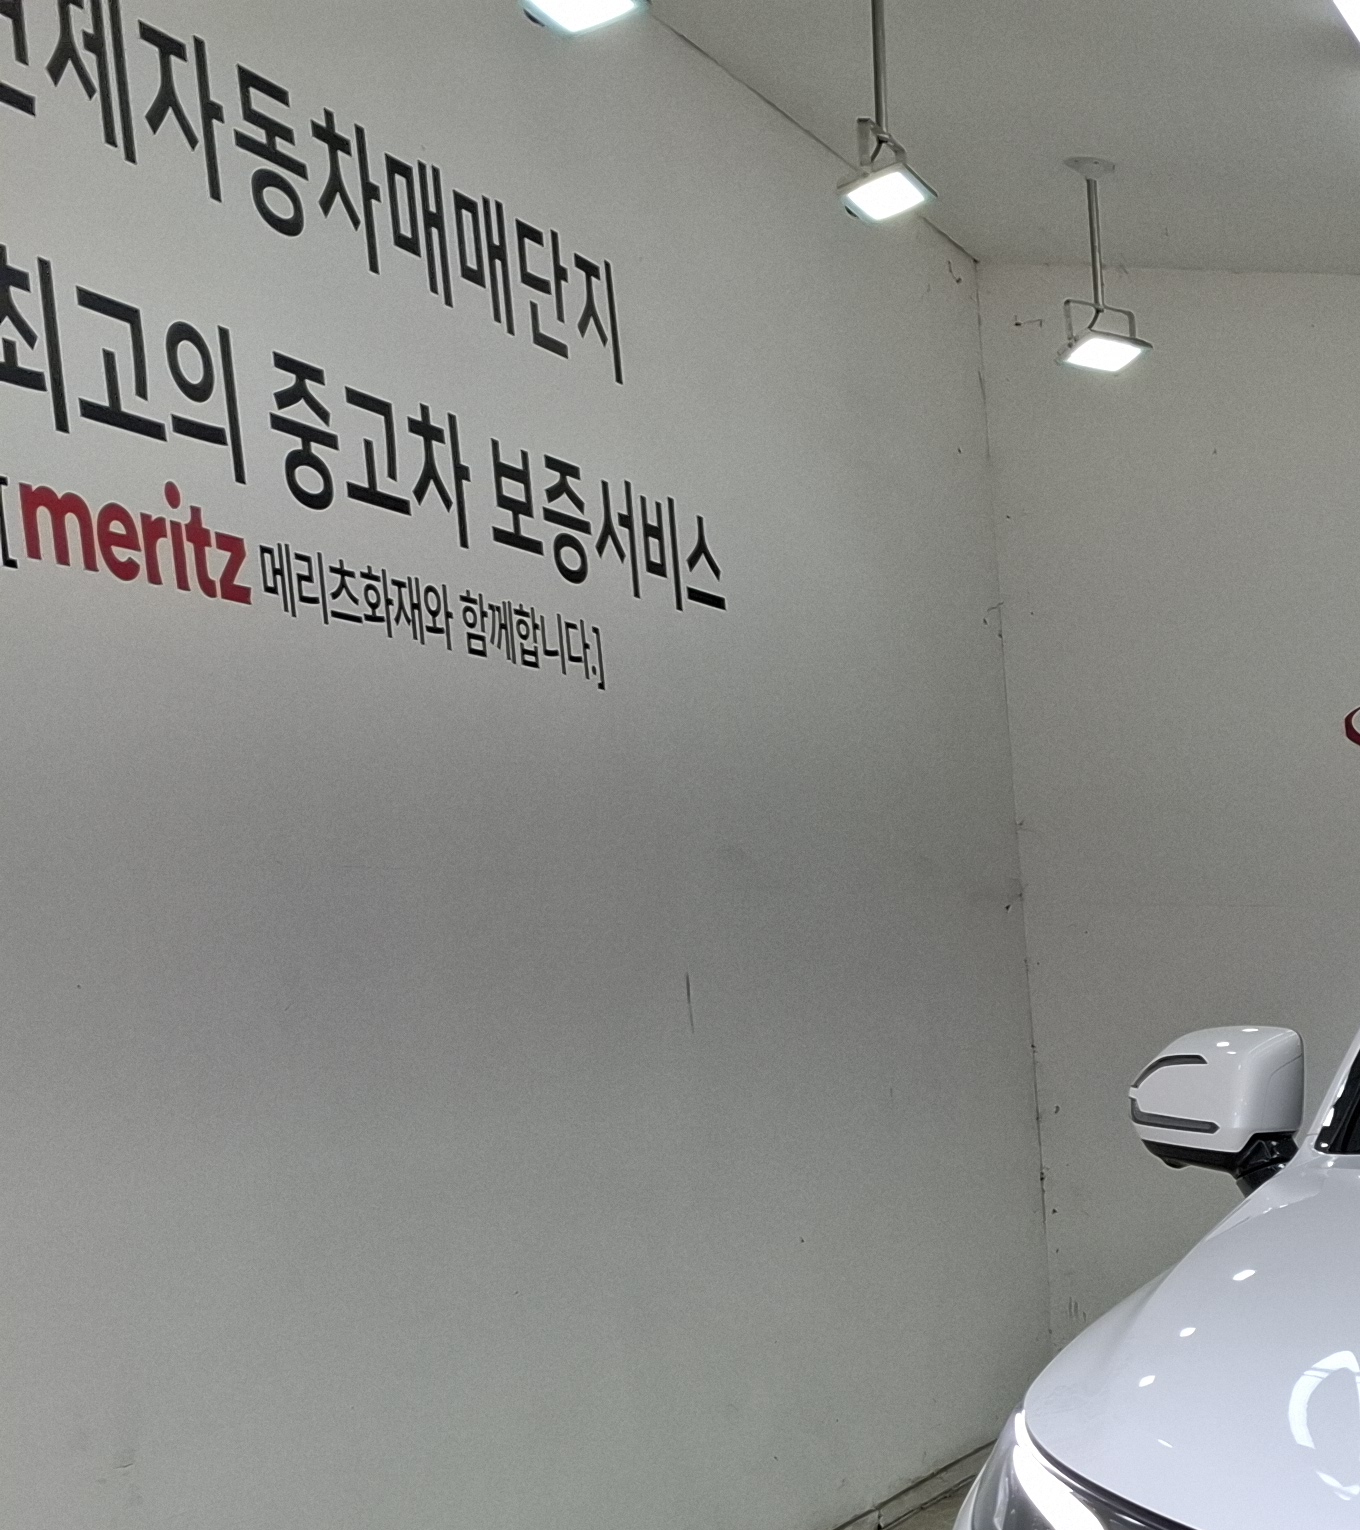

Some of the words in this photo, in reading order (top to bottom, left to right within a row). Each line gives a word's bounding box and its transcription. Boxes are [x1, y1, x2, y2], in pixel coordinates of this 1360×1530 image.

[269, 351, 470, 549] 중고차
[490, 438, 726, 611] 보증서비스
[259, 543, 453, 651] 메리츠화재와
[459, 590, 605, 690] 함께합니다.]
